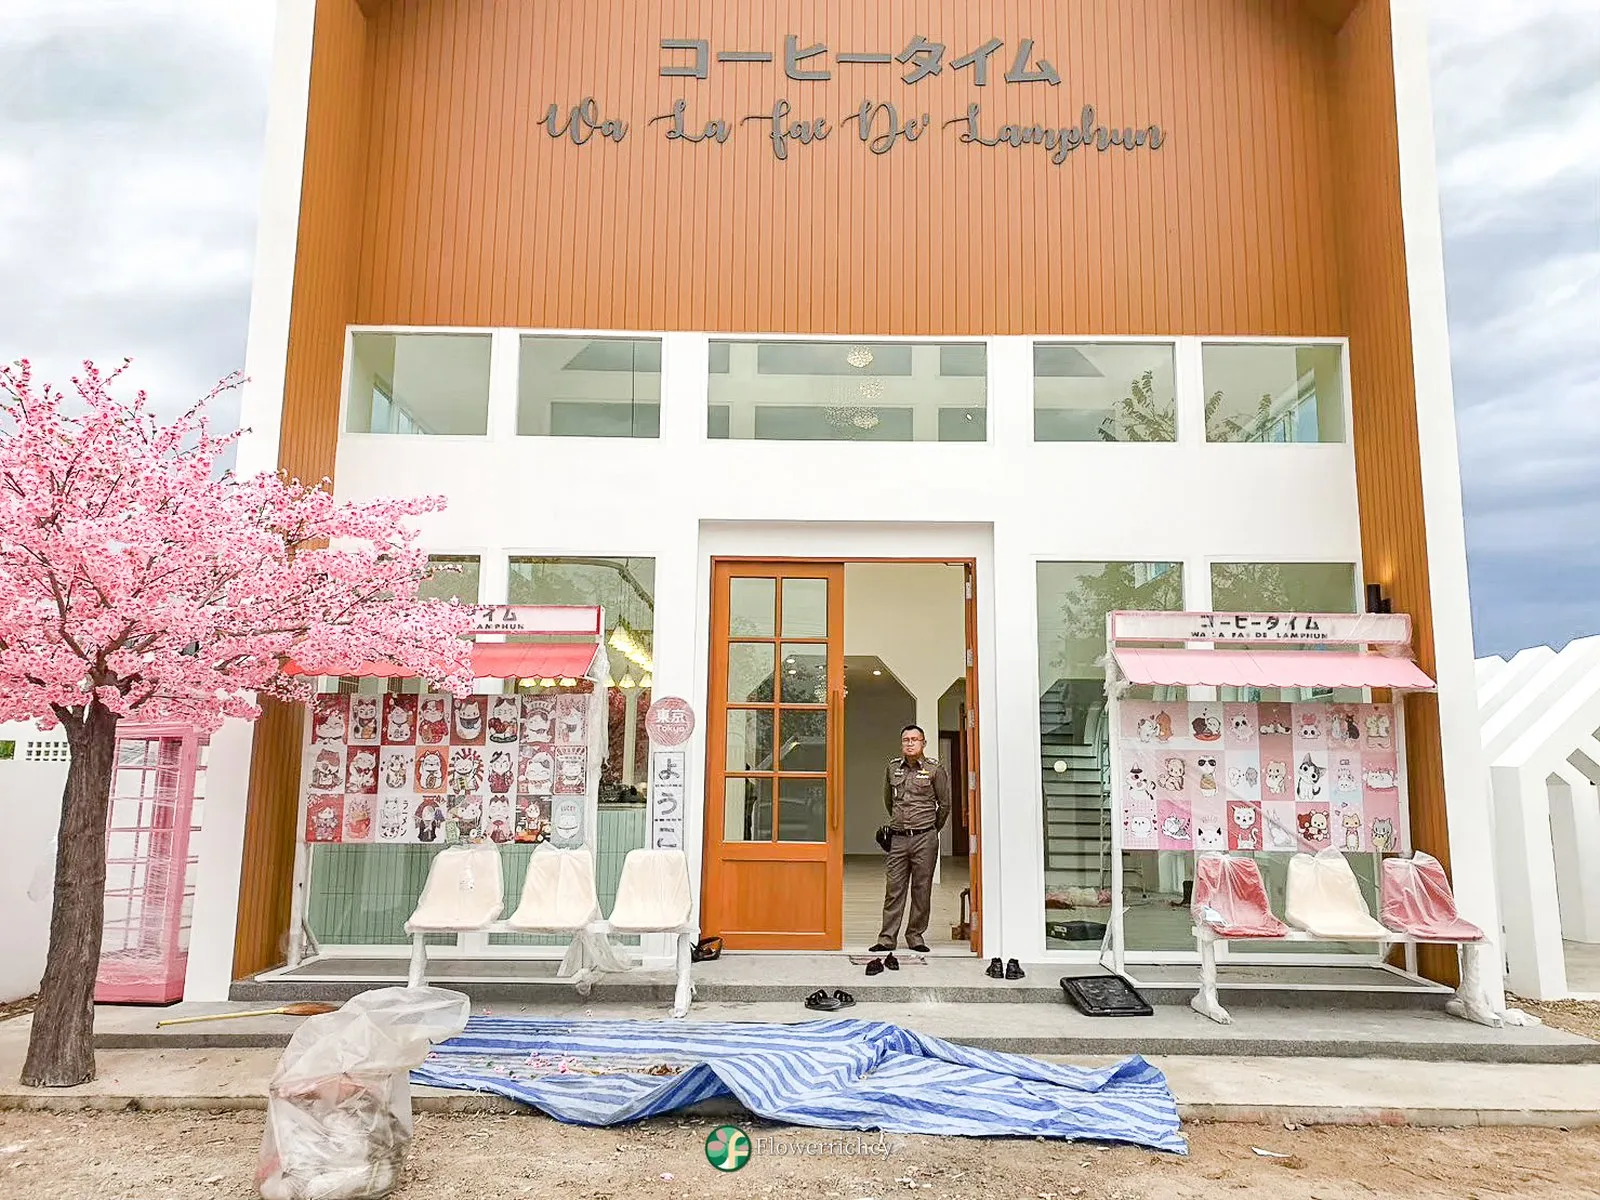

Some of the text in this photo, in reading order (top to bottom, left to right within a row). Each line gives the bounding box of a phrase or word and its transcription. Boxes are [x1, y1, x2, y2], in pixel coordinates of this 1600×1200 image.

[660, 34, 1062, 86] コーヒータイム
[538, 97, 629, 146] Wa
[649, 99, 733, 145] La
[943, 102, 1168, 165] Lamphun
[1200, 615, 1320, 631] コーヒータイム
[656, 709, 686, 724] 東京
[656, 724, 686, 733] Tokyo
